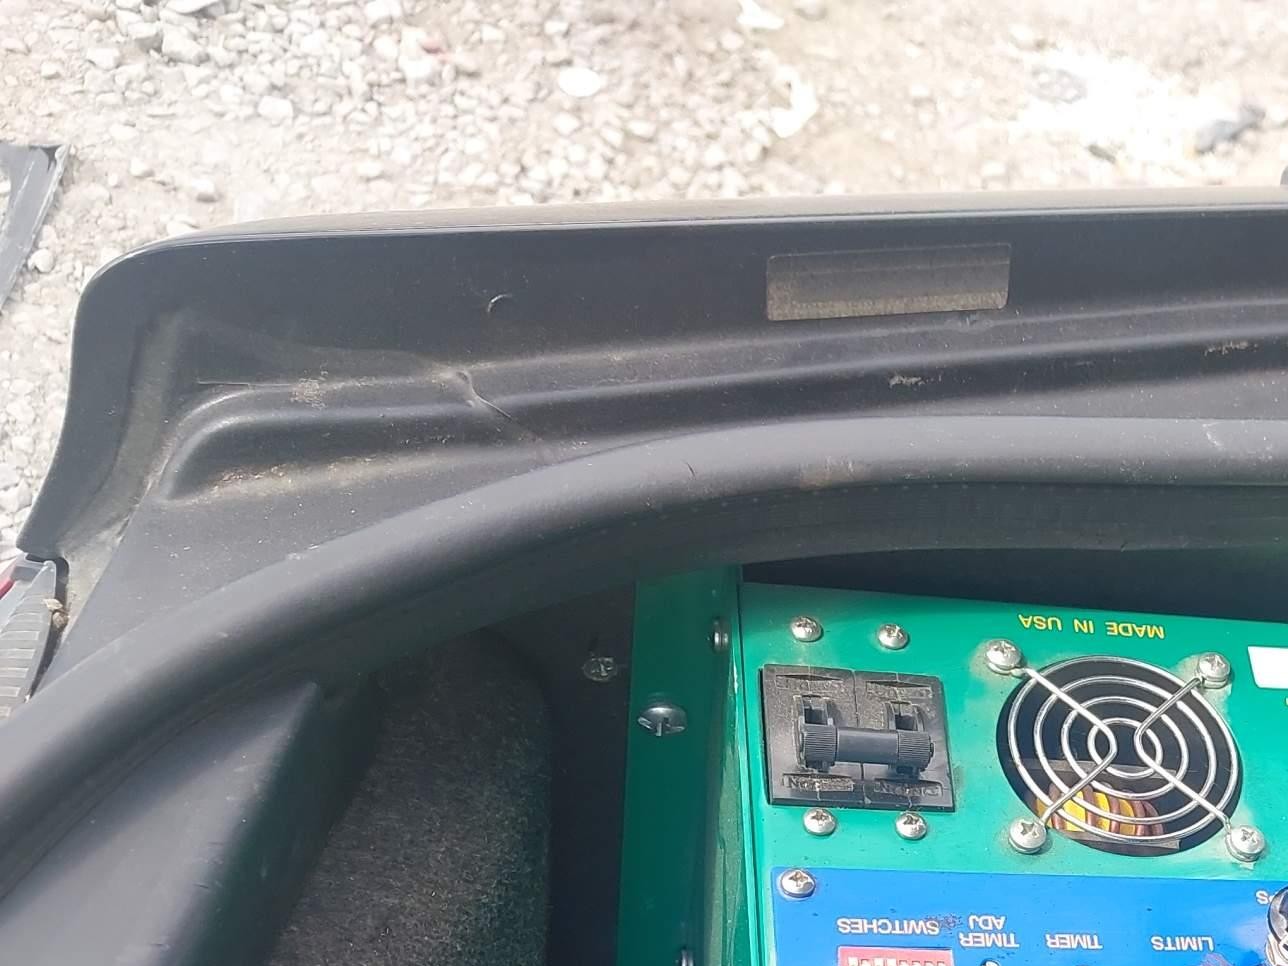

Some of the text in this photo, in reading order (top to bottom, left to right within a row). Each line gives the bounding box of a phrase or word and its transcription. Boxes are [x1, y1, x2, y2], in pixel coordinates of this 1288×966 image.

[1018, 614, 1165, 639] MADE IN USA
[837, 917, 940, 936] SWITCHES
[968, 914, 1006, 931] ADJ
[958, 931, 1019, 948] TIMER
[1044, 933, 1103, 949] TIMER
[1150, 935, 1215, 952] LIMITS
